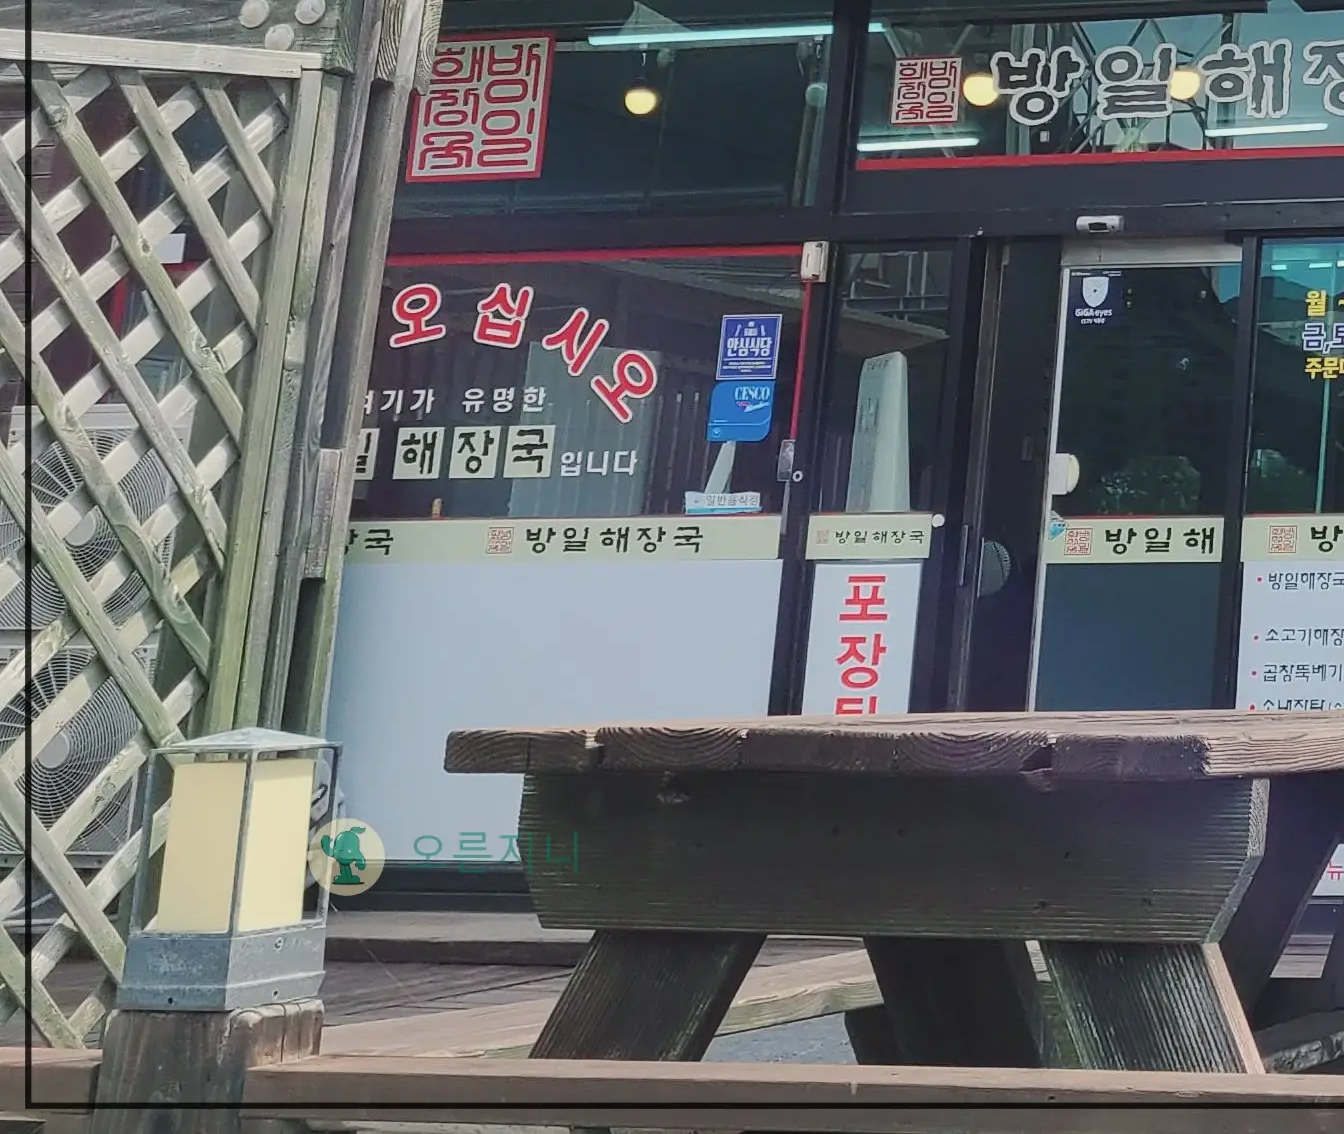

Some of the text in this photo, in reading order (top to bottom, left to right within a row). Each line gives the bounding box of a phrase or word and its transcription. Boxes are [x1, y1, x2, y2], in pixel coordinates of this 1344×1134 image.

[1305, 289, 1327, 316] 월
[389, 282, 657, 424] 오십시오
[726, 337, 773, 358] 안심식당
[462, 386, 547, 414] 유명한
[734, 385, 771, 401] CESCO
[559, 449, 638, 477] 입니다
[526, 526, 704, 554] 방일해장국
[835, 530, 925, 545] 방일해장국
